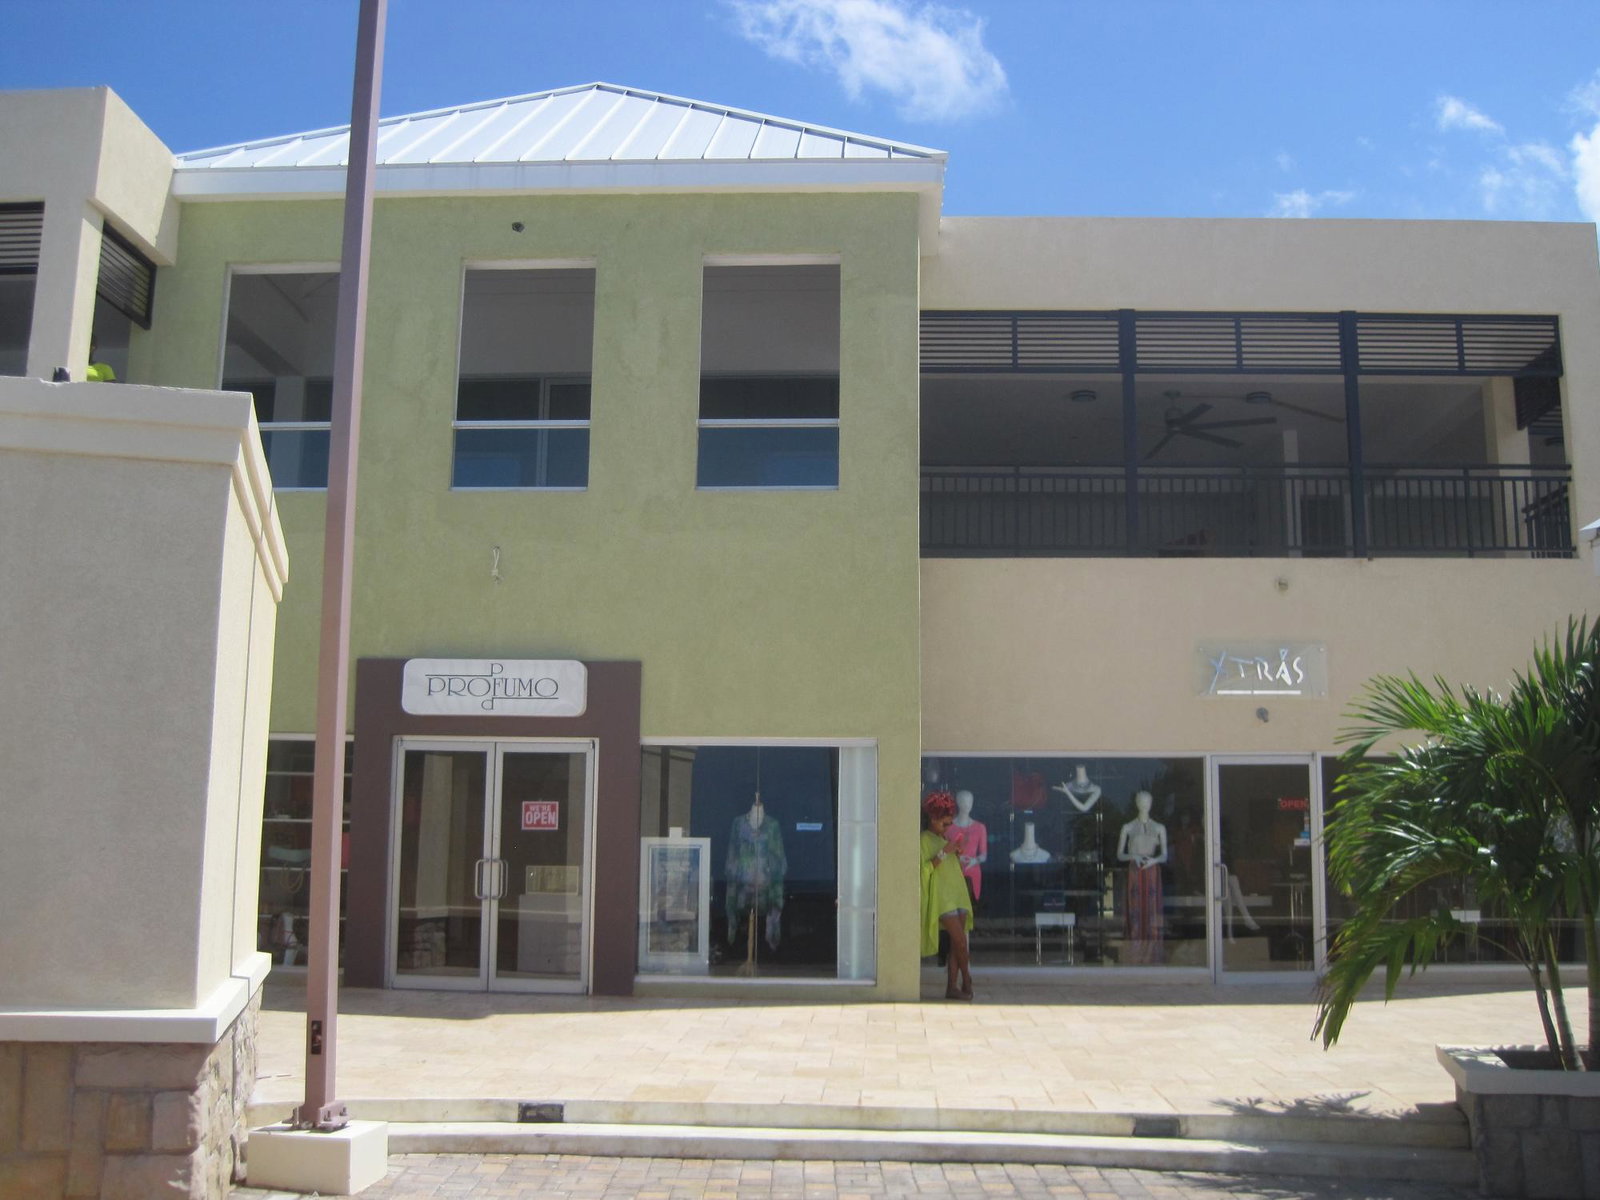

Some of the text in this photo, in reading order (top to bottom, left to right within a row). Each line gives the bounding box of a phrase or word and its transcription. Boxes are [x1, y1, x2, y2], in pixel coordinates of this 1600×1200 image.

[427, 676, 559, 698] PROFUMO
[1280, 799, 1308, 808] OPEN
[525, 811, 556, 825] OPEN
